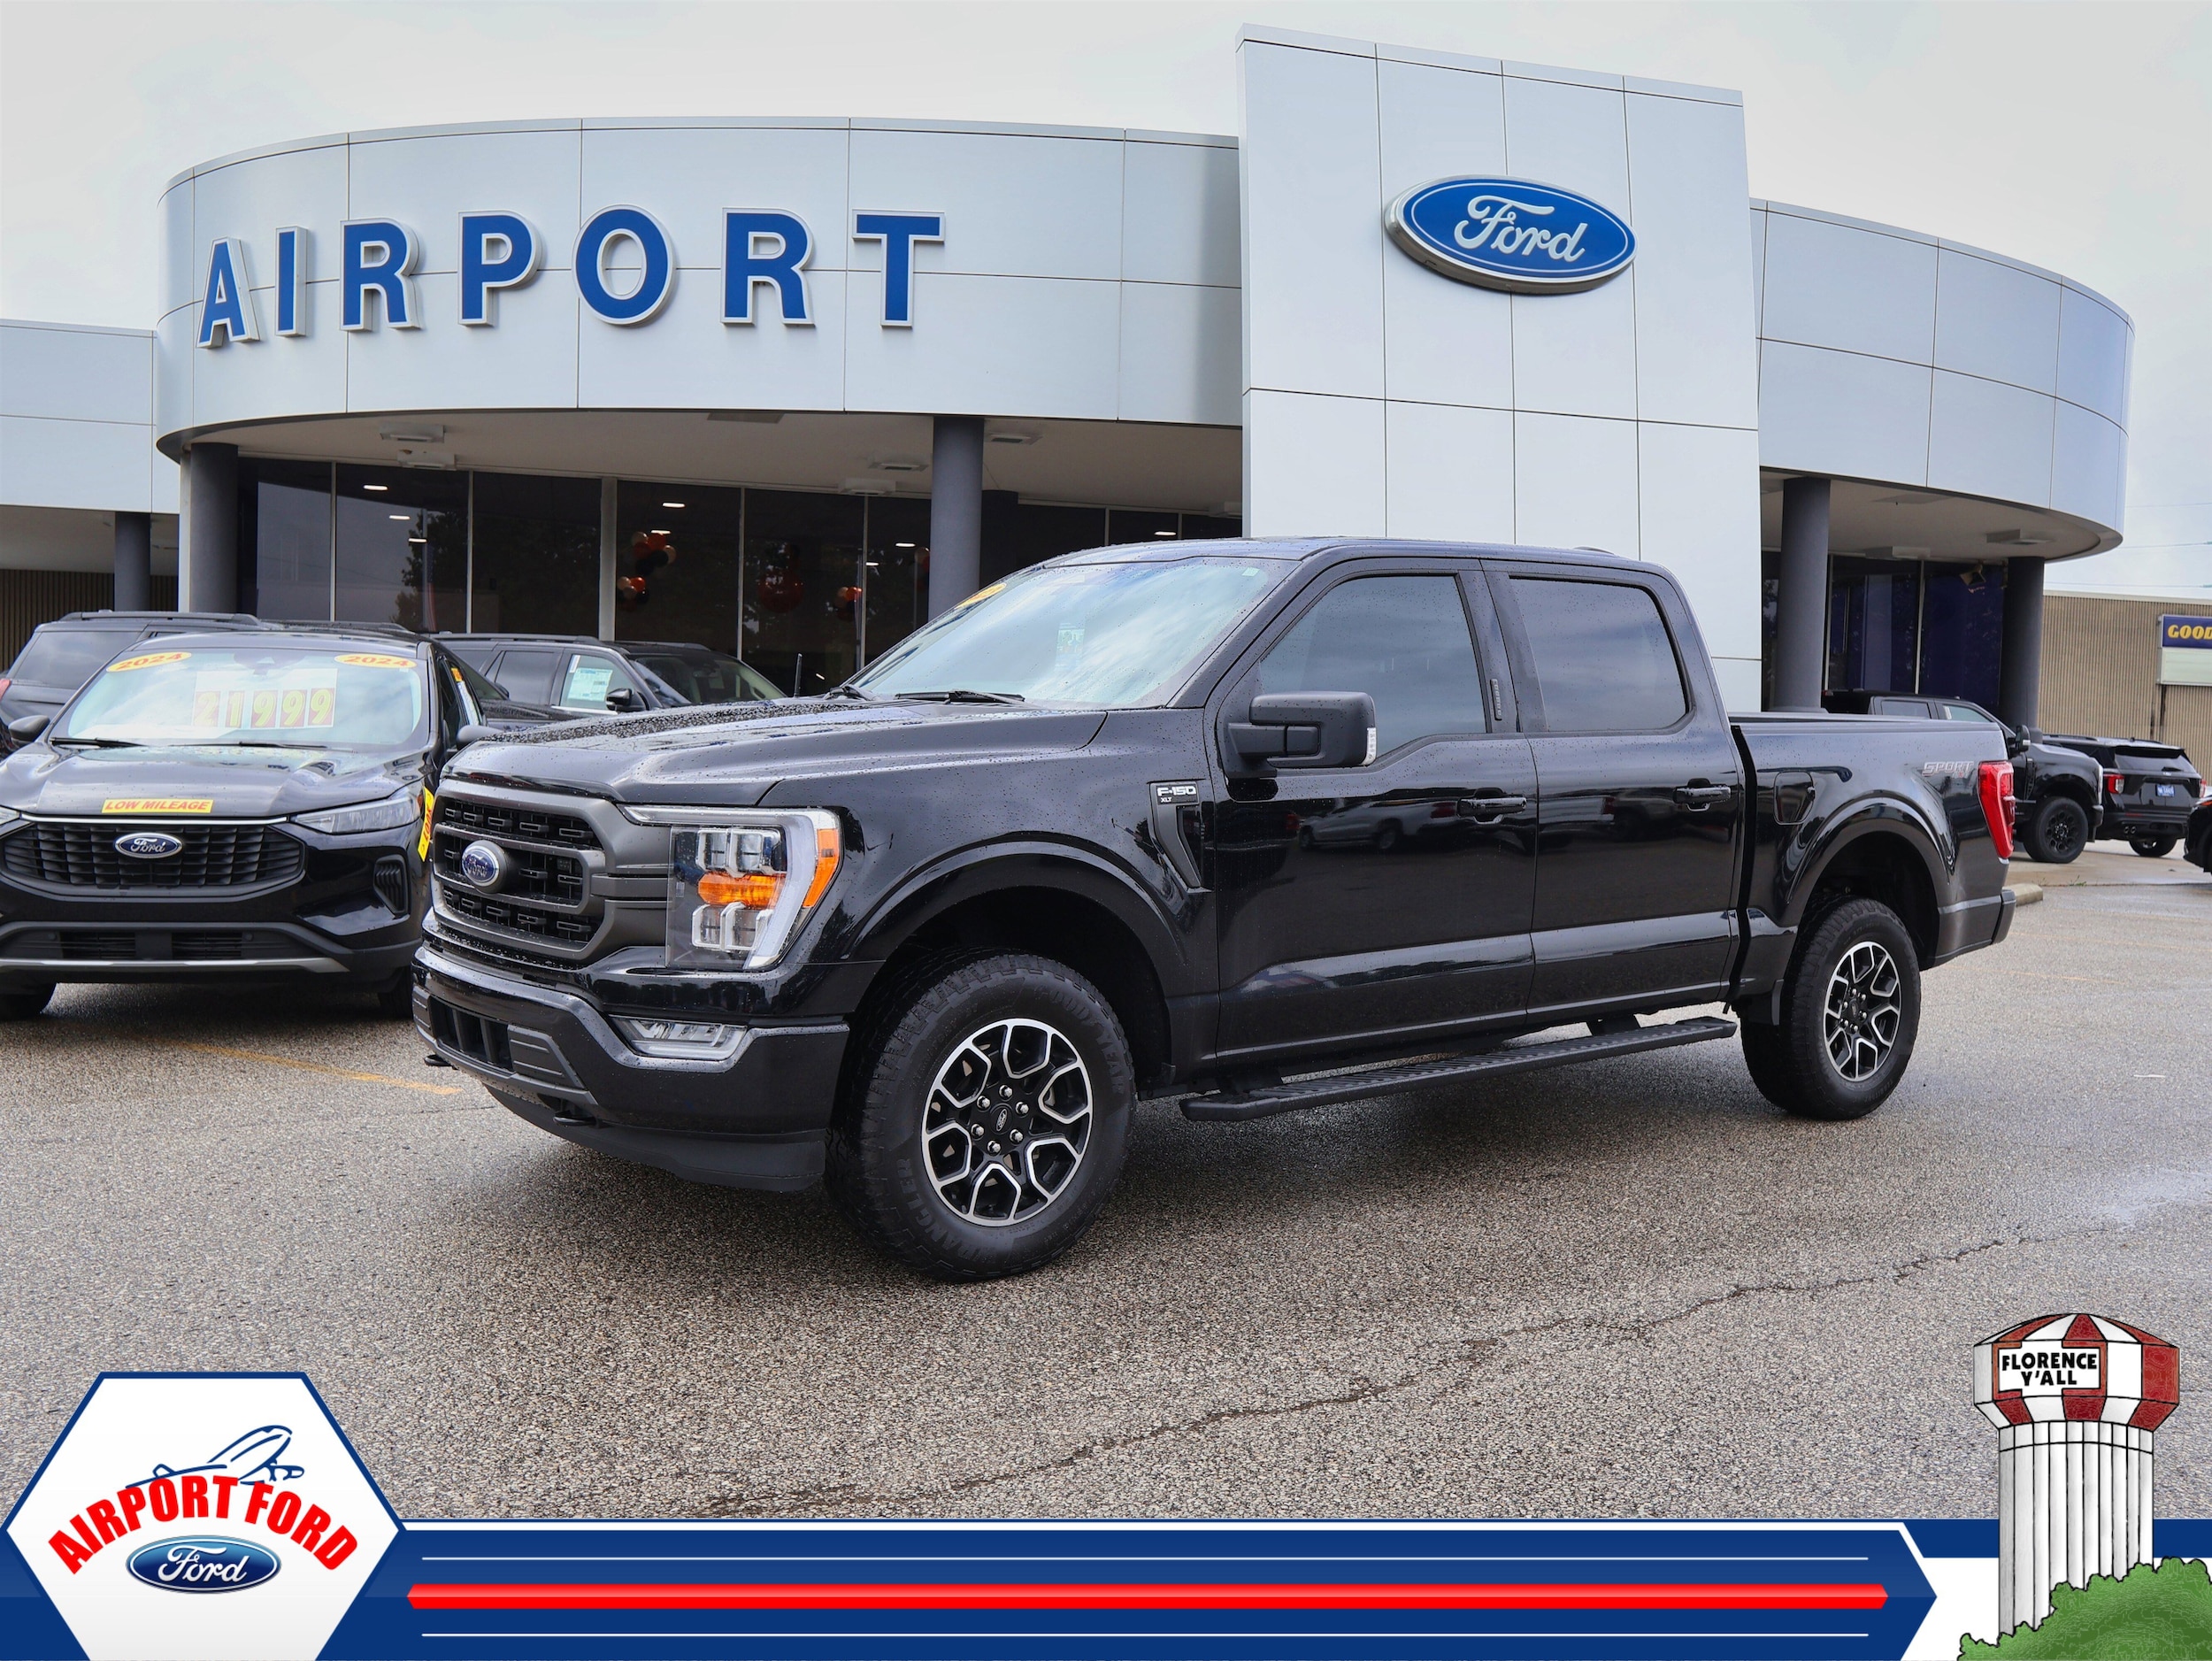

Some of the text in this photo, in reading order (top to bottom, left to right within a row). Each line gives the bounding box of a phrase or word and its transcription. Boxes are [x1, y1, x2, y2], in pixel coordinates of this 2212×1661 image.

[1454, 195, 1588, 263] Ford
[196, 204, 945, 349] AIRPORT
[116, 652, 182, 671] 2024
[343, 656, 409, 667] 2024
[194, 688, 333, 727] 21999
[1921, 761, 1974, 777] SPORT
[105, 801, 210, 811] LOW MILEAGE
[130, 837, 166, 853] Ford
[465, 853, 488, 878] Ford
